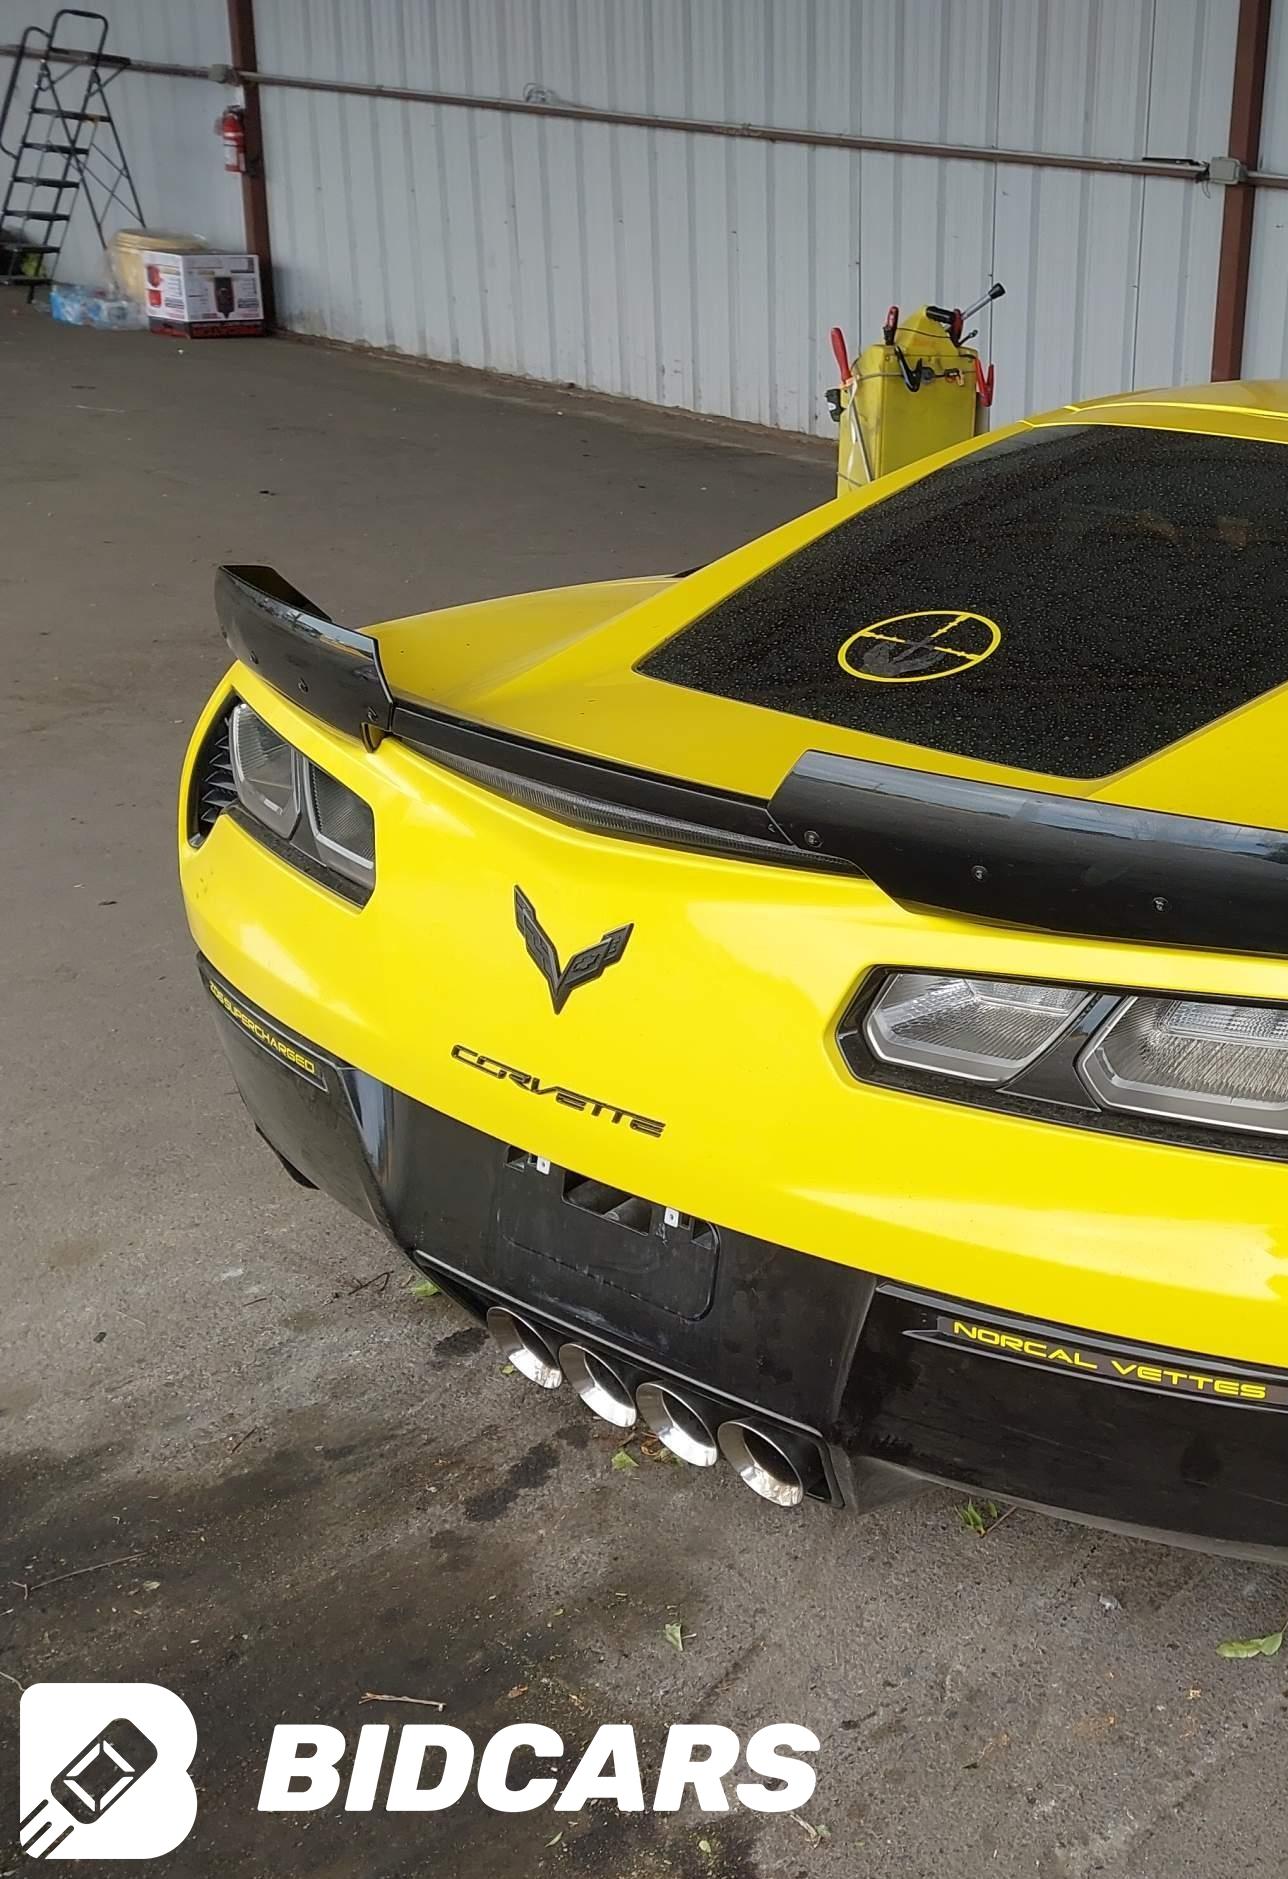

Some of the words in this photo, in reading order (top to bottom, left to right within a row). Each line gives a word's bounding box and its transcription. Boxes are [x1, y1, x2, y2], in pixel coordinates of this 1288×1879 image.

[223, 997, 315, 1074] SUPERCHARGED
[451, 1044, 667, 1138] CORVETTE
[953, 1321, 1099, 1370] NORCAL
[1111, 1360, 1267, 1400] VETTES
